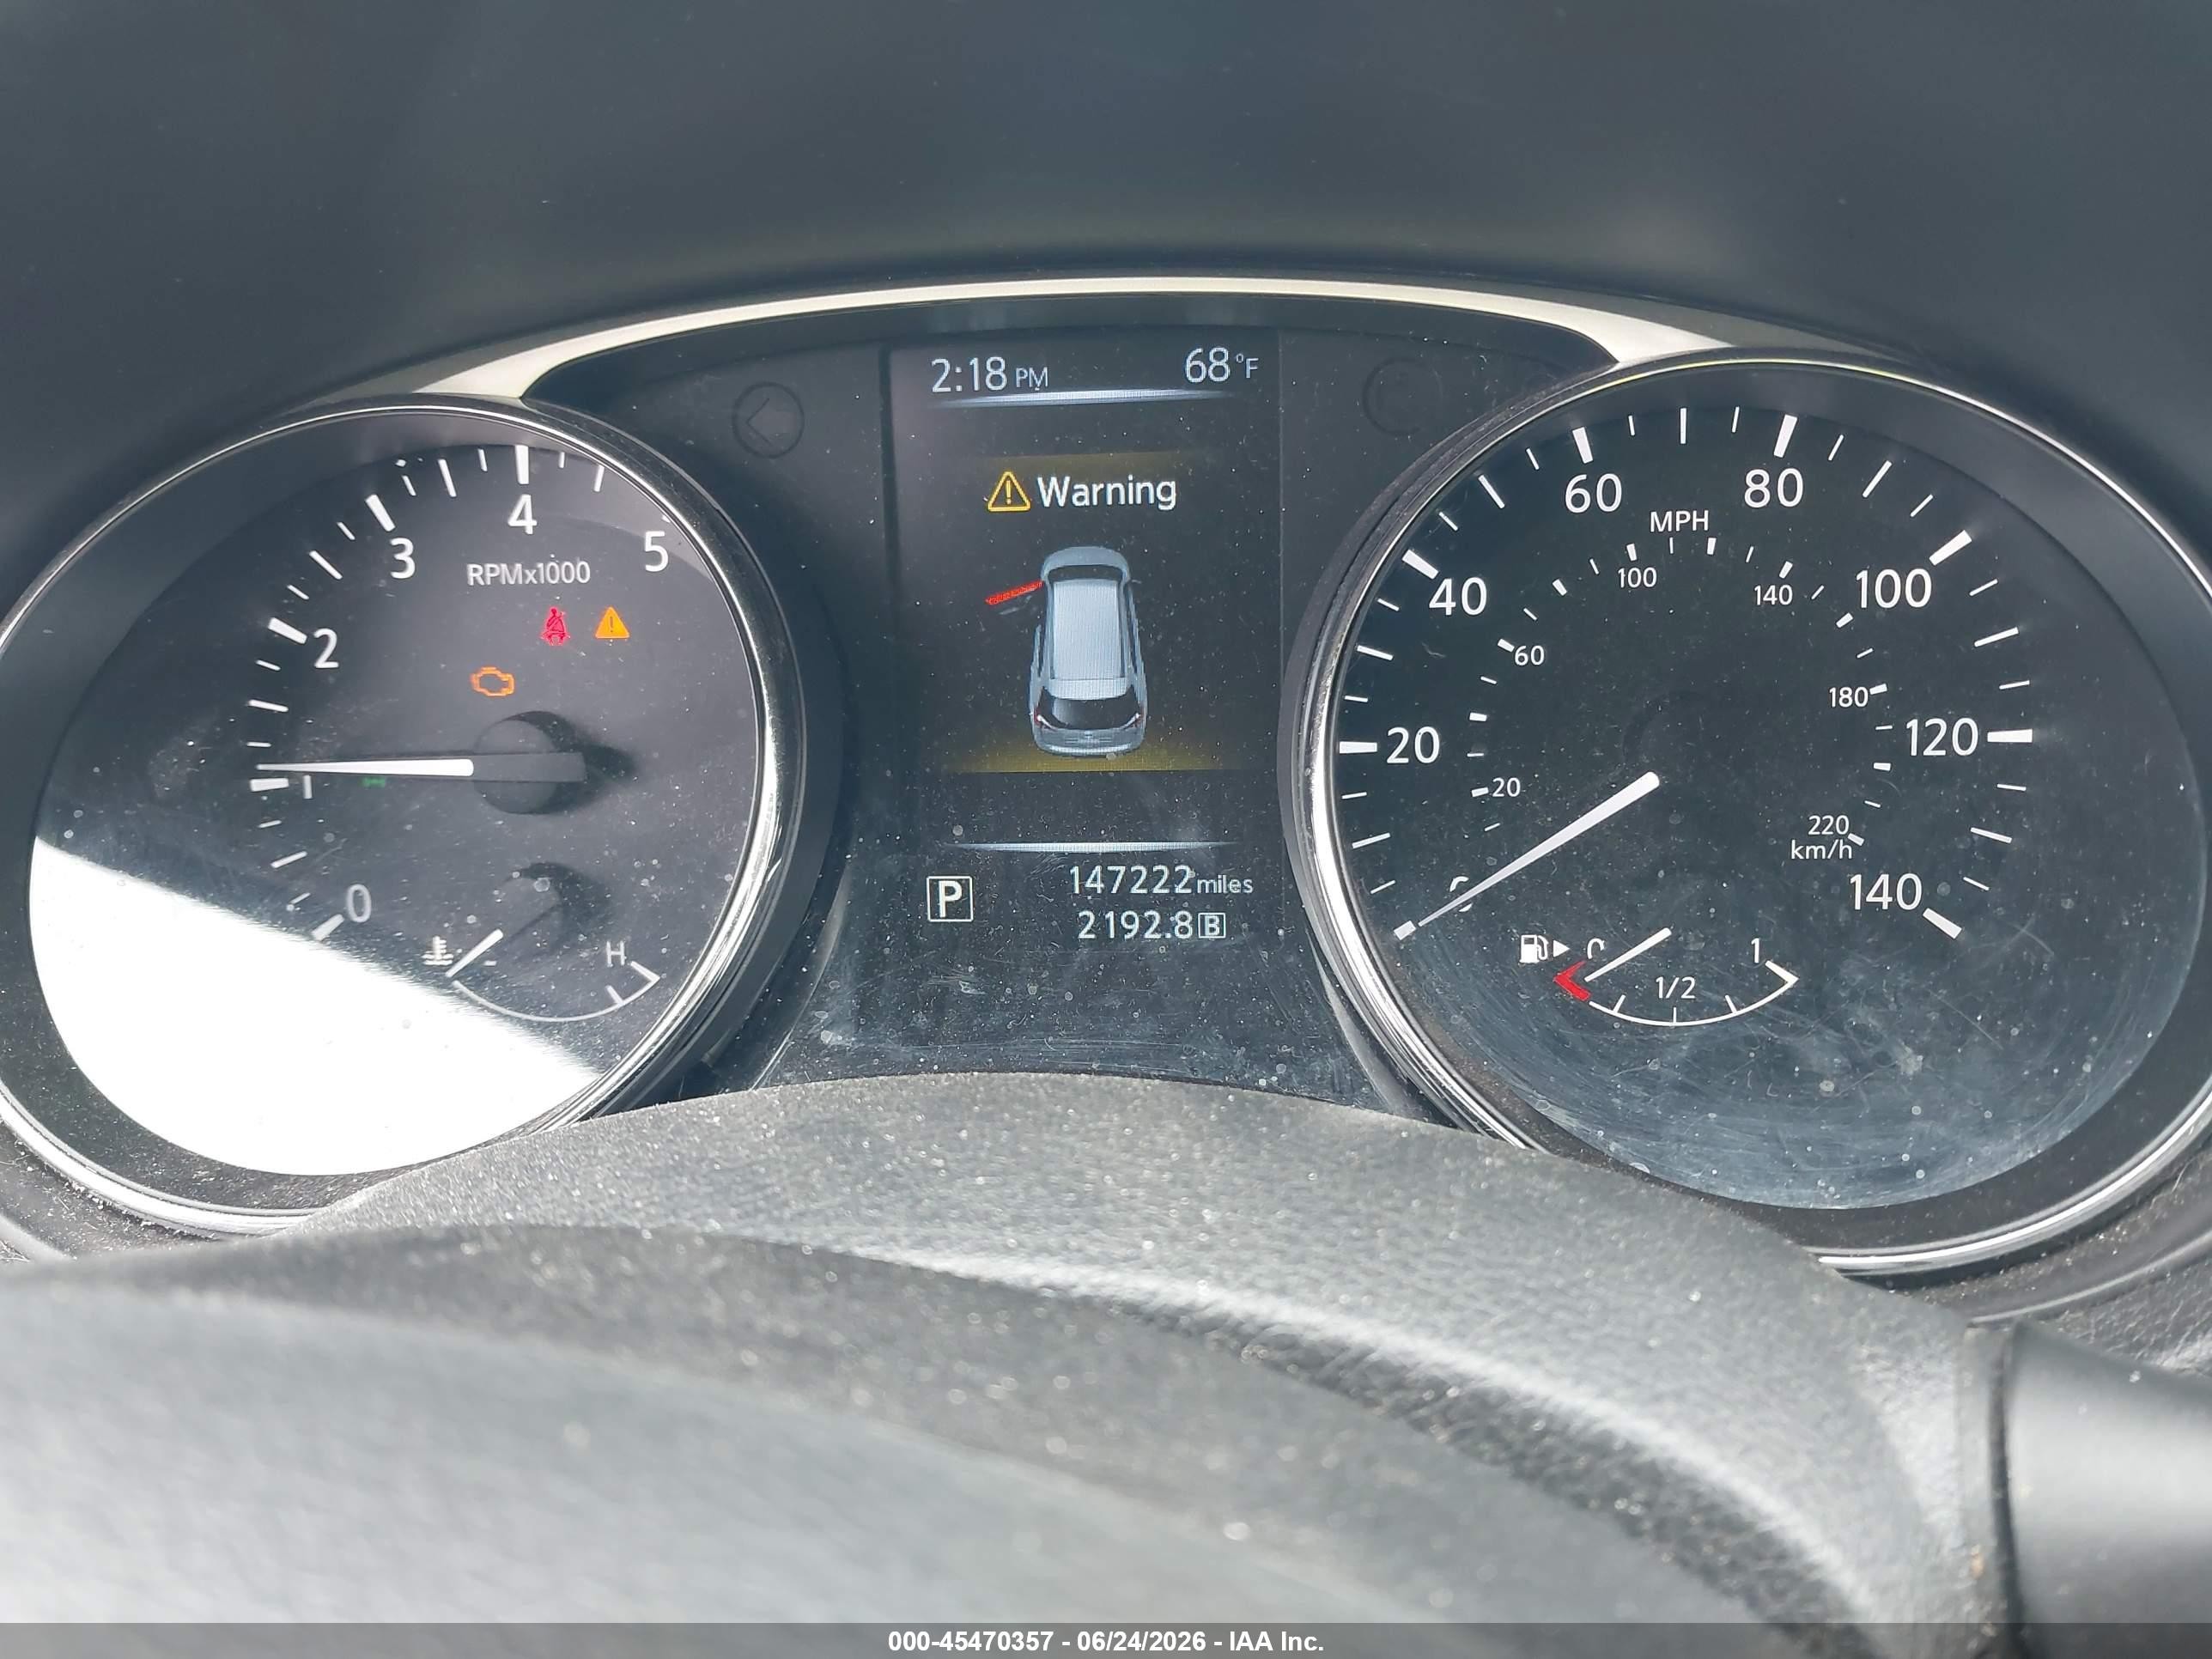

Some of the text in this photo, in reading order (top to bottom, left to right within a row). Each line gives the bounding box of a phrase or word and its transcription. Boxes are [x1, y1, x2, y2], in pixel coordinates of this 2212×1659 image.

[931, 356, 1048, 393] 2:18 PM
[1036, 475, 1176, 511] Warning
[1565, 473, 1622, 514] 60
[1744, 468, 1803, 508] 80
[508, 494, 537, 534] 4
[1650, 510, 1709, 532] MPH
[391, 538, 416, 579] 3
[644, 531, 668, 571] 5
[466, 561, 590, 586] RPMx1000
[1617, 567, 1657, 588] 100
[1855, 568, 1932, 609] 100
[1428, 577, 1487, 616] 40
[1753, 584, 1793, 605] 140
[313, 629, 339, 669] 2
[1514, 645, 1545, 665] 60
[1828, 686, 1869, 708] 180
[1386, 726, 1440, 764] 20
[1905, 718, 1978, 757] 120
[1492, 777, 1521, 798] 20
[1808, 815, 1850, 836] 220
[1790, 839, 1853, 860] km/h
[345, 884, 372, 923] 0
[938, 880, 963, 919] P
[1849, 873, 1923, 911] 140
[1078, 910, 1194, 940] 2192.8
[606, 940, 626, 966] H
[1751, 938, 1760, 963] 1
[1655, 975, 1696, 1000] 1/2
